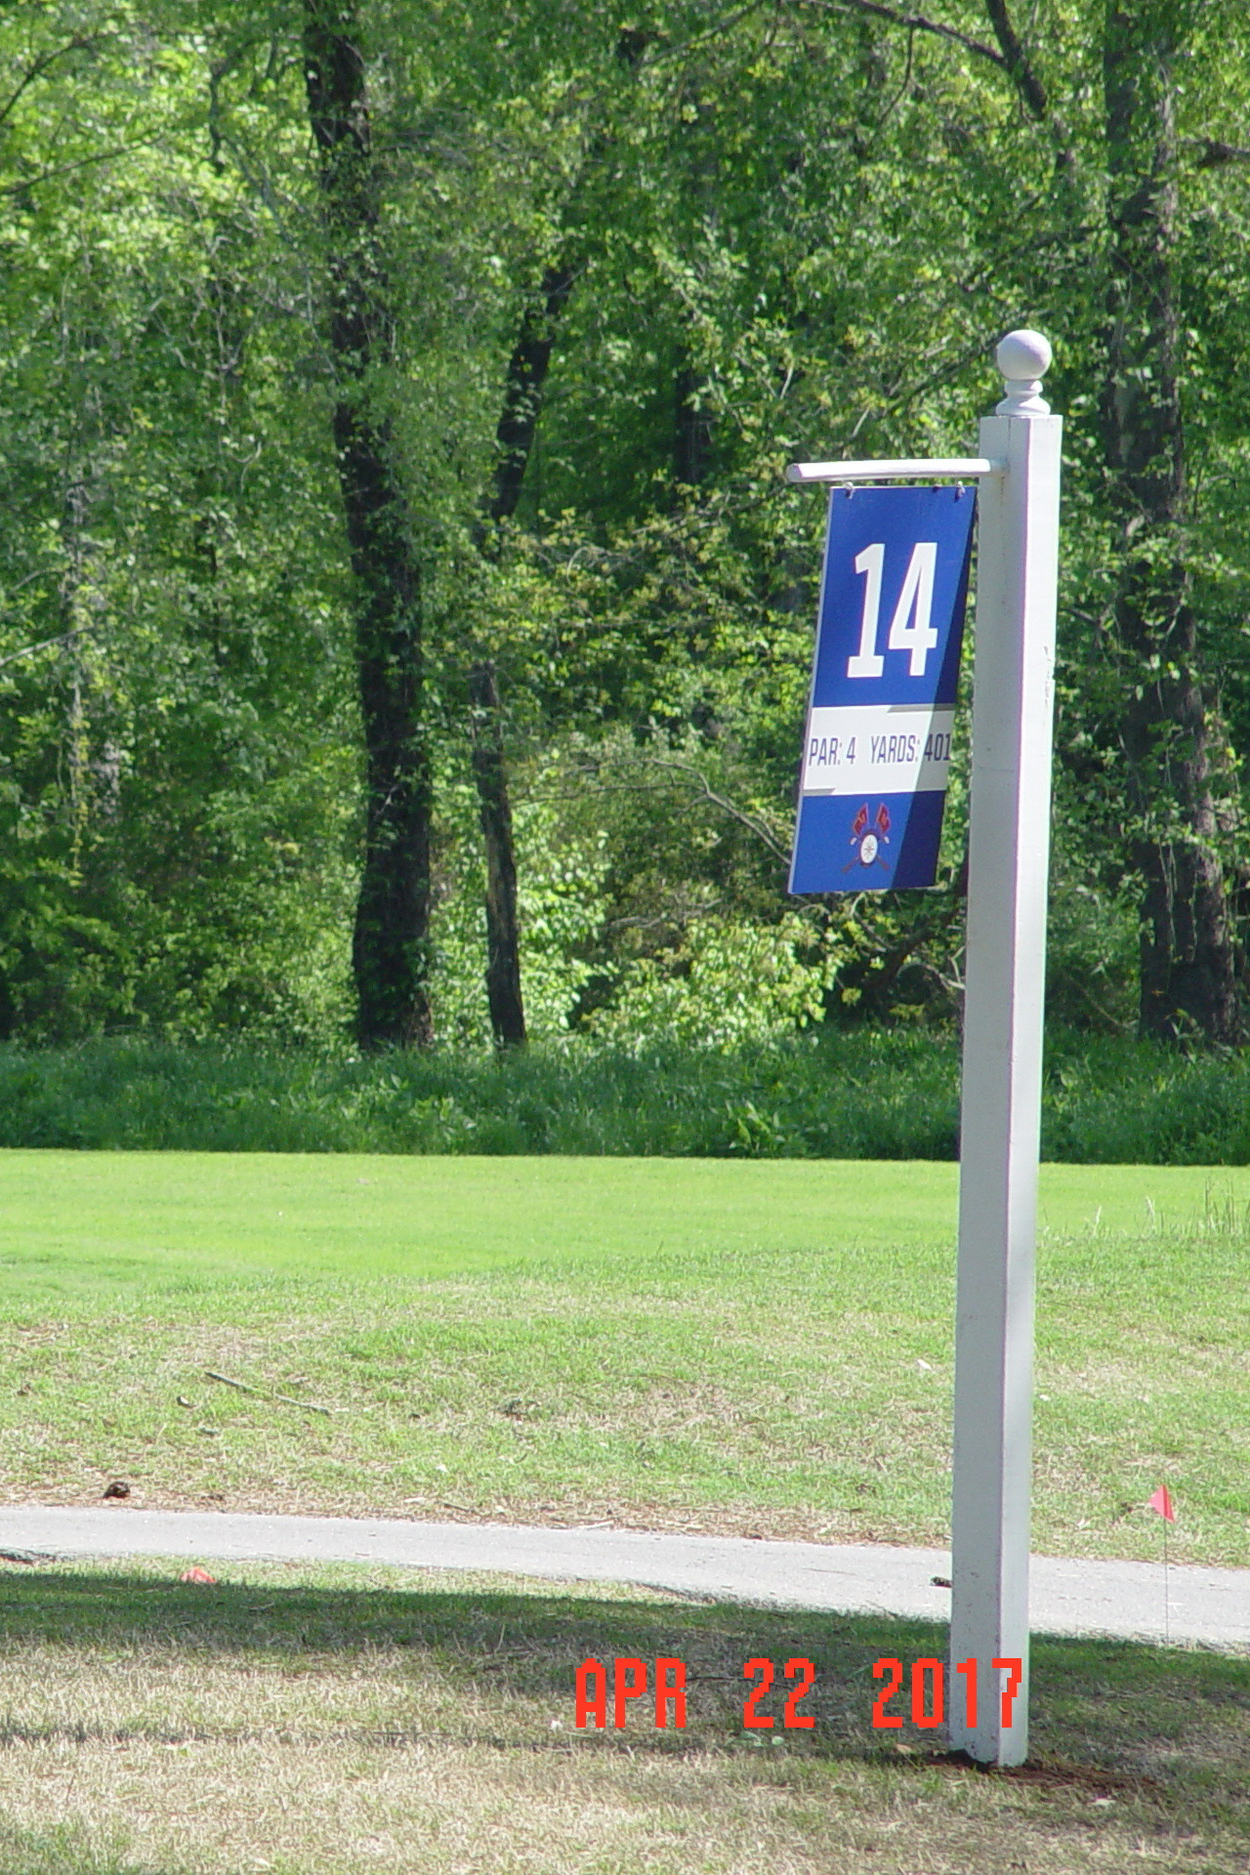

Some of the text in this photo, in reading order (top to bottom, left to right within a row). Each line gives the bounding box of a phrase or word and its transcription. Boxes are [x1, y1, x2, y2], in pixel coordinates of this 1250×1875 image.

[847, 542, 938, 678] 14
[808, 732, 951, 766] PAR: 4 YARDS: 401
